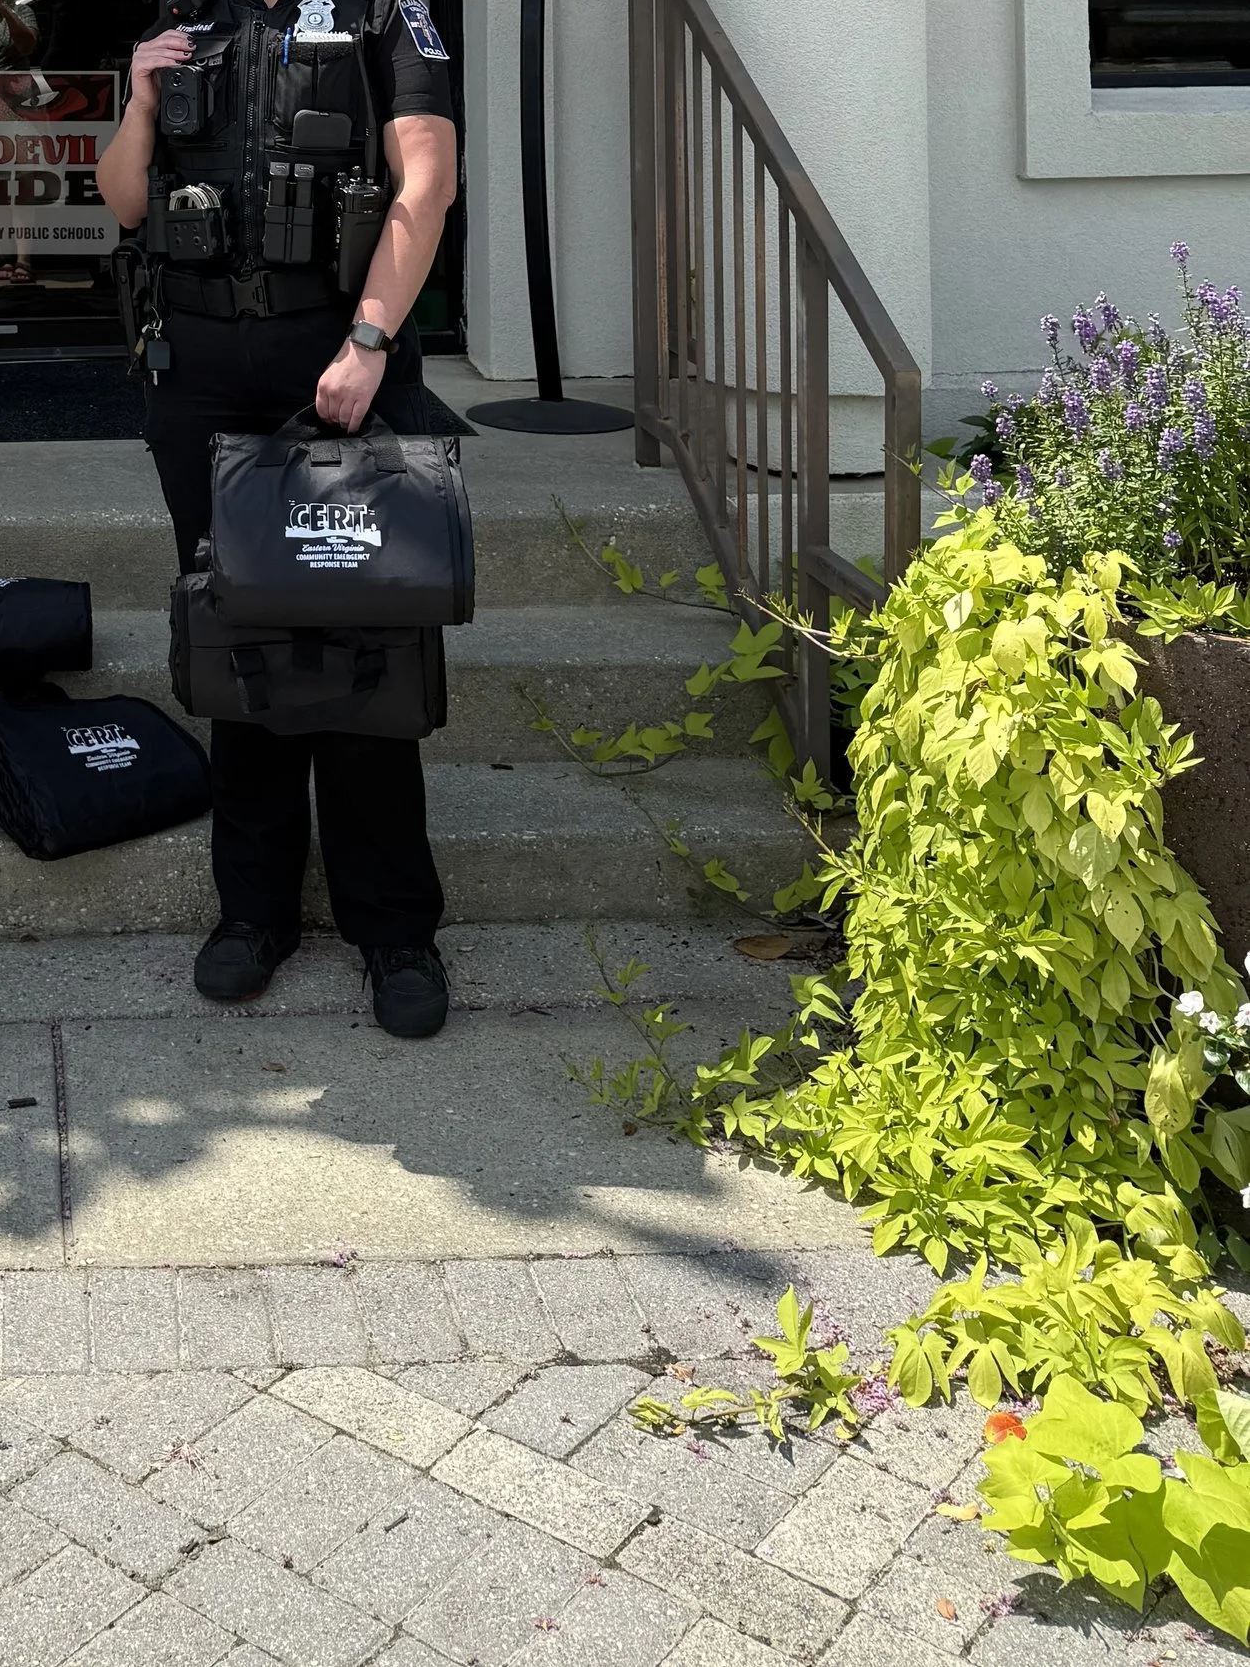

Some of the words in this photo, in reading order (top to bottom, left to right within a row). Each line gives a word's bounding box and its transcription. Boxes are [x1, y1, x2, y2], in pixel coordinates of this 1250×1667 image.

[7, 226, 49, 240] PUBLIC
[52, 226, 105, 240] SCHOOLS
[289, 502, 368, 532] CERT
[332, 543, 365, 553] Virginia
[66, 723, 123, 746] CERT
